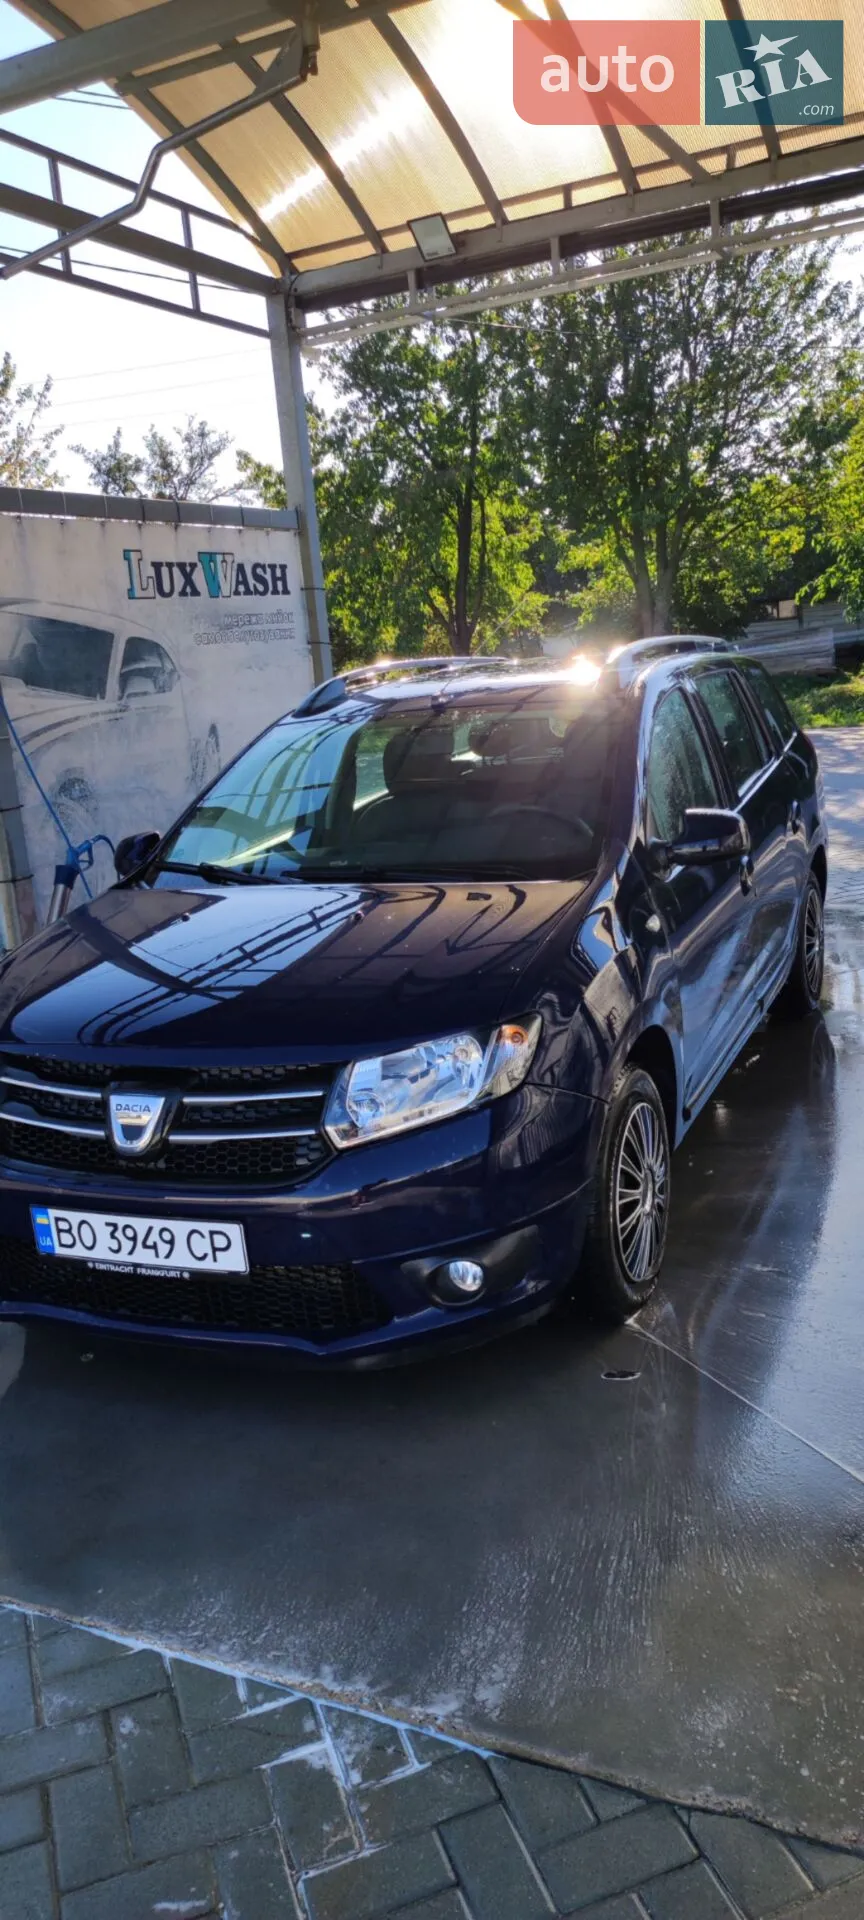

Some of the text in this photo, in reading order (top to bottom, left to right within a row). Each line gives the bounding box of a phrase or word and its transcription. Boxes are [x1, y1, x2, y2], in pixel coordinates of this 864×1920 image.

[115, 1103, 151, 1113] DACIA
[40, 1216, 232, 1262] UA BO 3949 CP
[94, 1262, 181, 1278] EINTRACHT FRANKFURT
